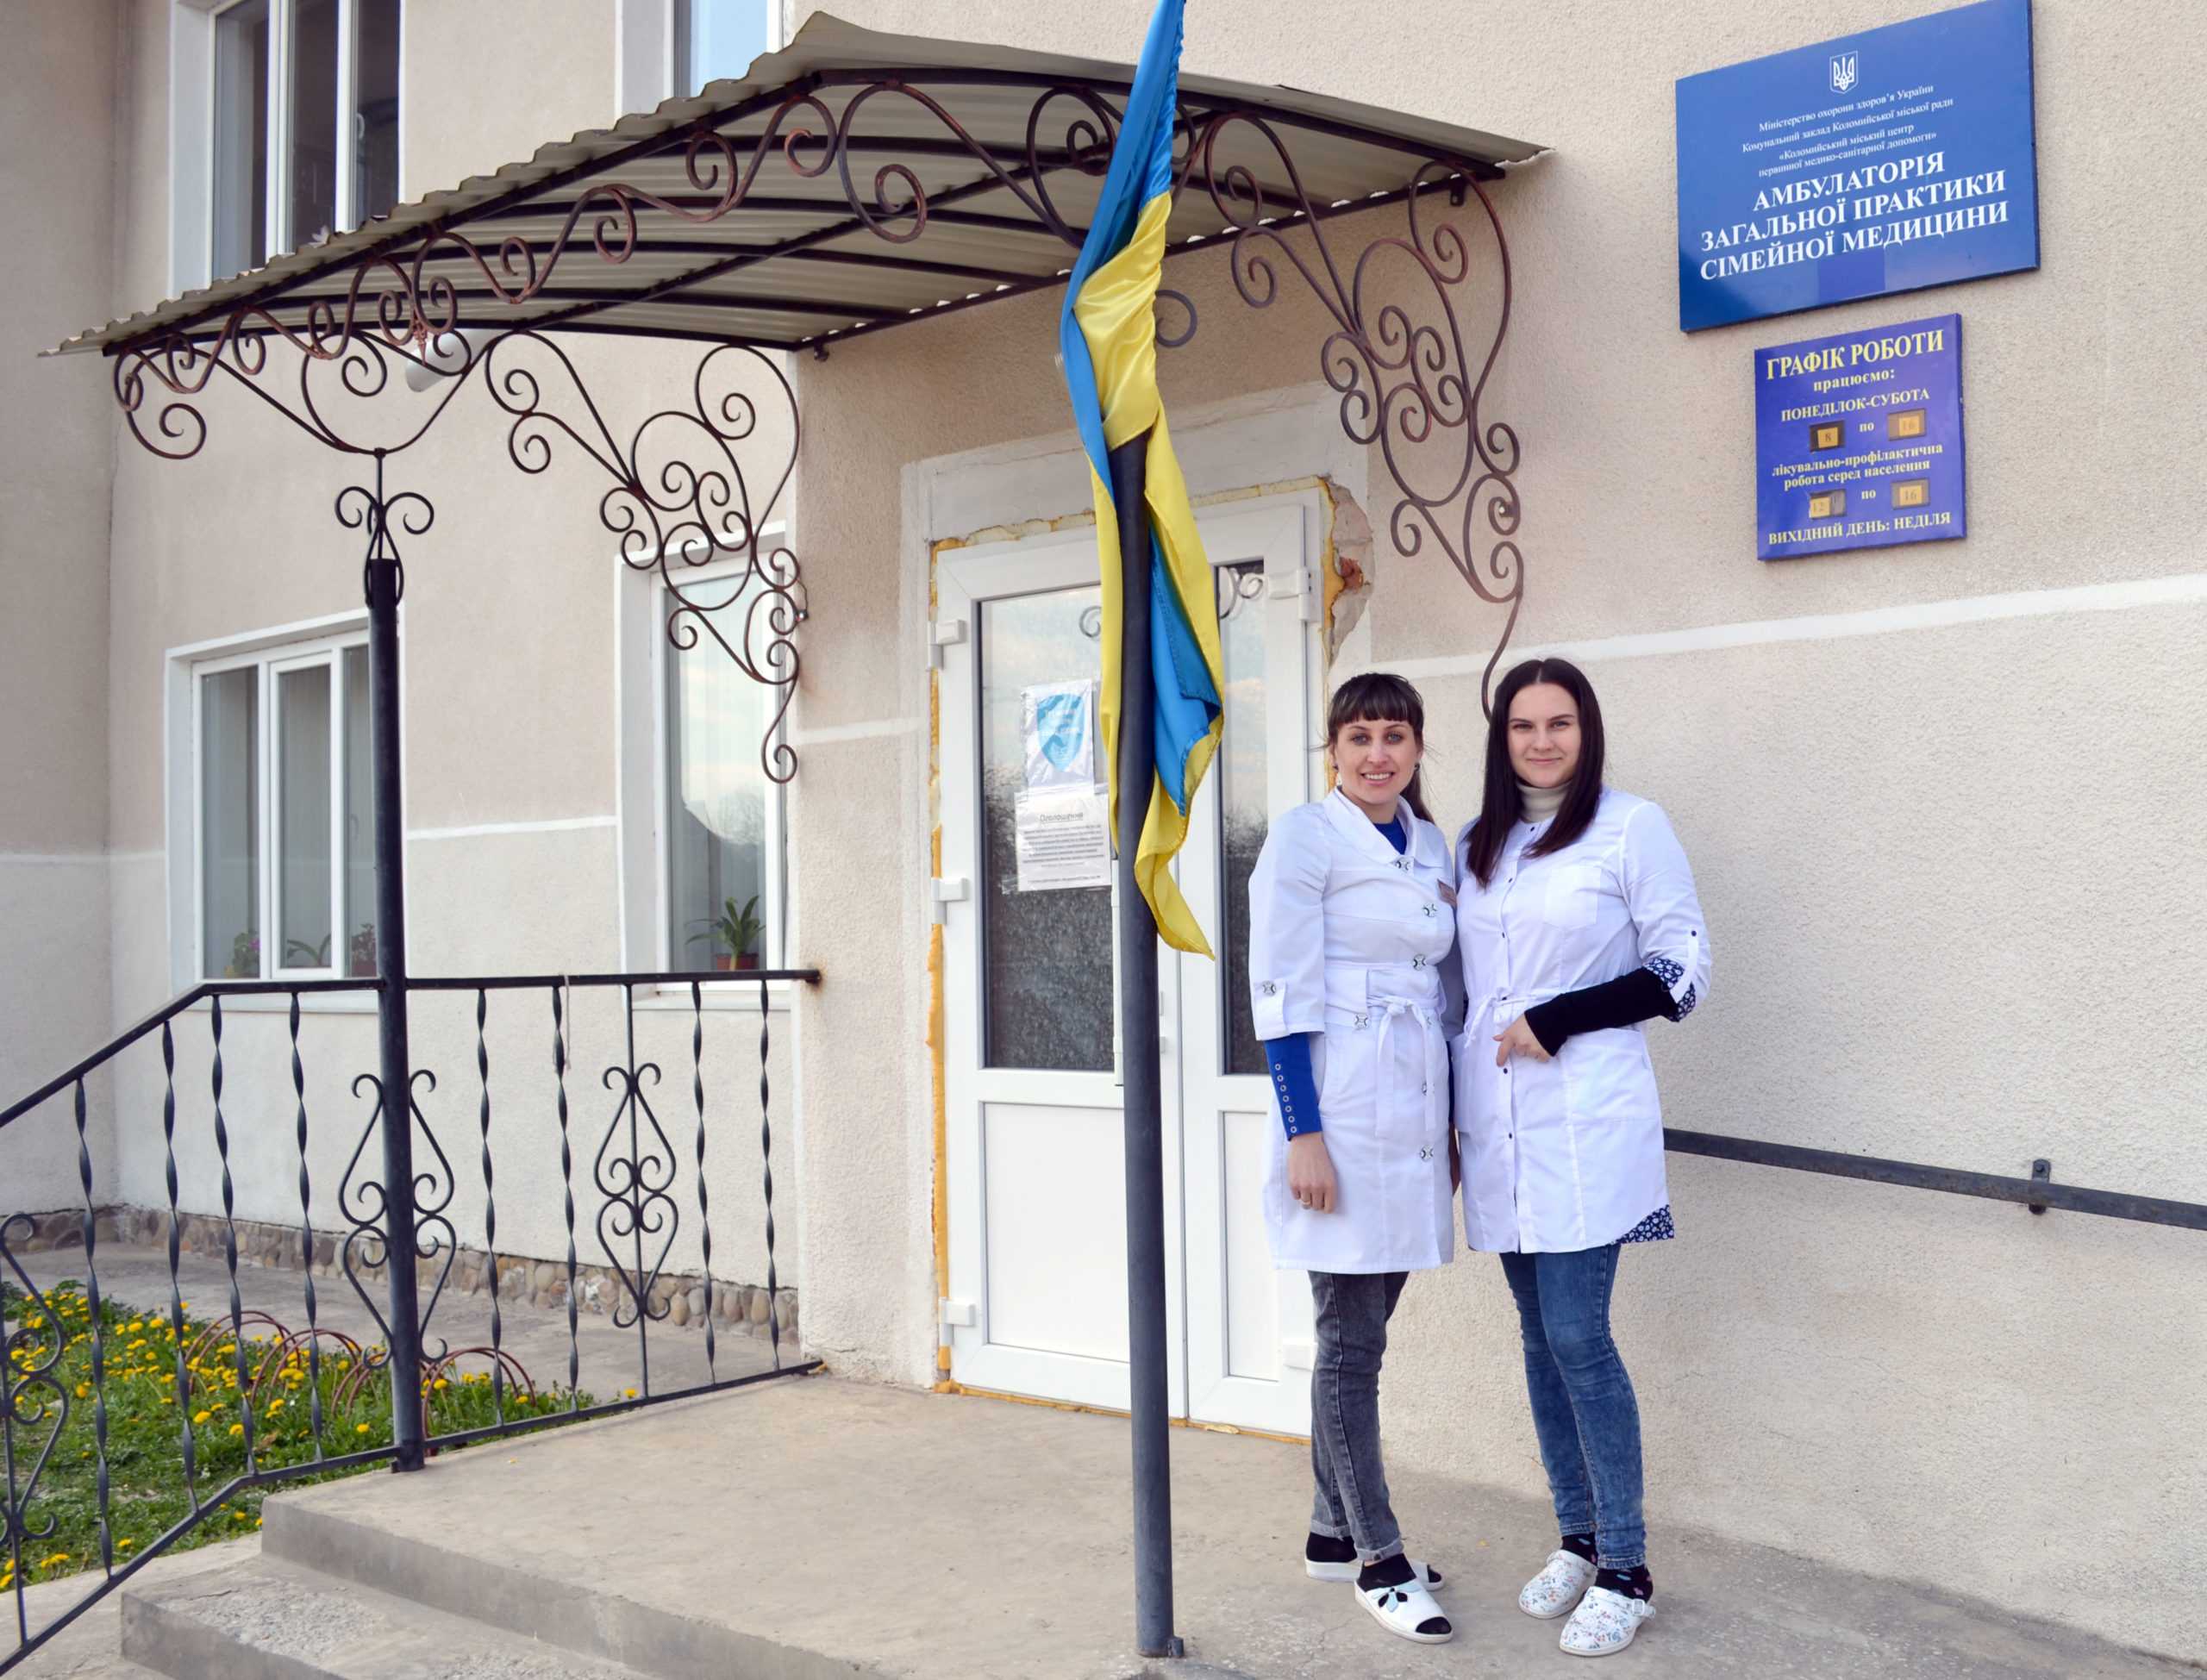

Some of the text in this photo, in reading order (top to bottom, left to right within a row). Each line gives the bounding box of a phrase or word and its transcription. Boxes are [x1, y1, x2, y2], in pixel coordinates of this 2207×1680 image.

[1759, 112, 1816, 132] Міністерство
[1816, 103, 1854, 118] охорони
[1896, 84, 1934, 101] України
[1741, 98, 1954, 153] Комунальний заклад Коломийської міської ради
[1849, 128, 1885, 146] міський
[1887, 123, 1915, 139] центр
[1759, 132, 1937, 178] первинної медико-санітарної допомоги»
[1753, 151, 1946, 212] АМБУЛАТОРІЯ
[1701, 170, 2006, 252] ЗАГАЛЬНОЇ ПРАКТИКИ
[1700, 200, 2010, 281] СІМЕЙНОЇ МЕДИЦИНИ
[1766, 329, 1945, 380] ГРАФІК РОБОТИ
[1813, 369, 1896, 393] працюємо:
[1780, 388, 1931, 422] ПОНЕДІЛОК-СУБОТА
[1859, 422, 1875, 433] по
[1772, 444, 1943, 478] лікувально-профілактична
[1784, 459, 1931, 491] робота серед населення
[1861, 490, 1877, 500] по
[1768, 512, 1951, 546] ВИХІДНИЙ ДЕНЬ: НЕДІЛЯ
